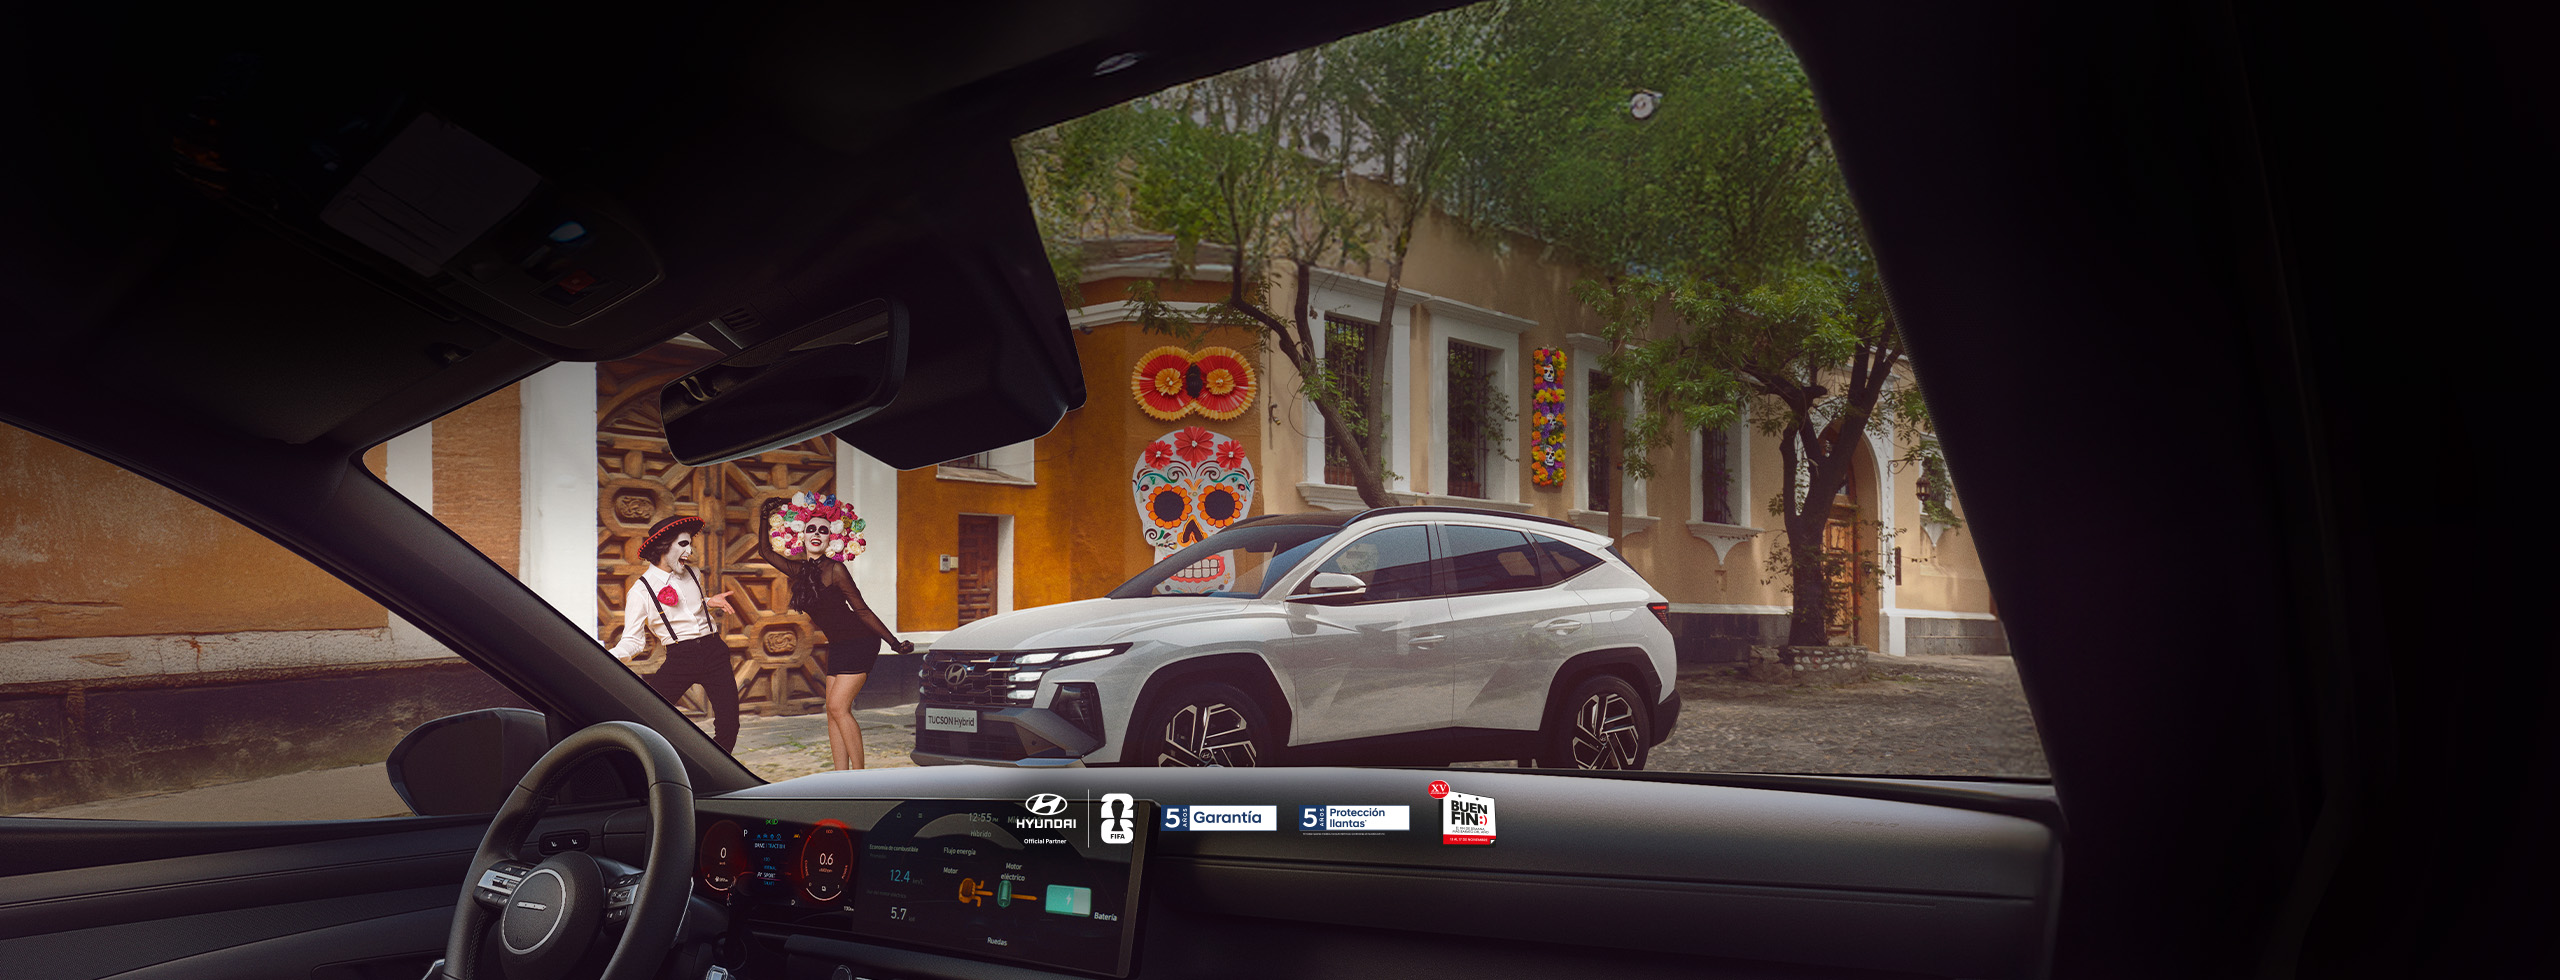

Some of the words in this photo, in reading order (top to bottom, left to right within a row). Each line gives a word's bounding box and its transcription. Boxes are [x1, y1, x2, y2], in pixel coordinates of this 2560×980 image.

[928, 715, 953, 725] TUCSON
[954, 717, 974, 728] Hybrid
[743, 829, 749, 837] P
[720, 847, 727, 859] 0
[943, 846, 956, 855] Flujo
[819, 852, 834, 866] 0.6
[943, 867, 959, 875] Motor
[1005, 862, 1023, 870] Motor
[890, 868, 911, 883] 12.4
[1000, 873, 1026, 882] eléctrico
[890, 906, 907, 921] 5.7
[1094, 911, 1118, 922] Batería
[987, 936, 1008, 946] Ruedas
